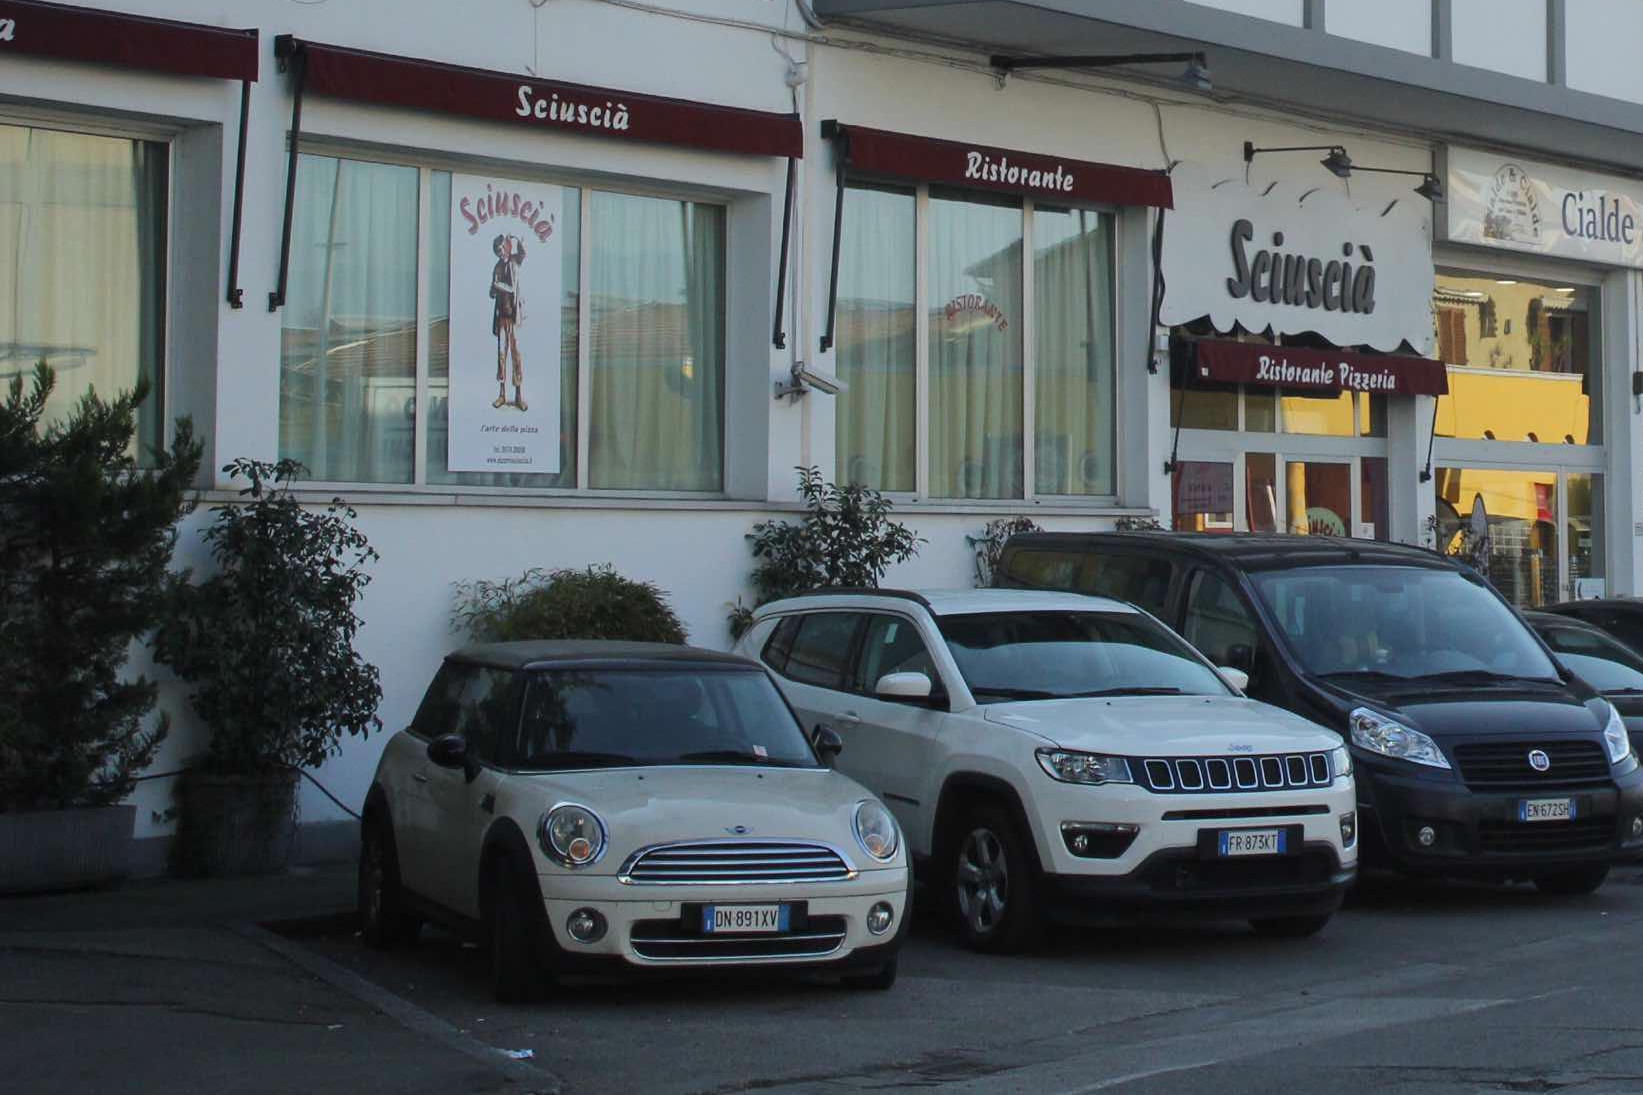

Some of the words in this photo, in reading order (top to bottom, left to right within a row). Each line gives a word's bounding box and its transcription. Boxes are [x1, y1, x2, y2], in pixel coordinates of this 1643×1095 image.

[515, 85, 630, 130] Sciuscià
[965, 151, 1074, 192] Ristorante
[459, 183, 555, 243] Sciuscià
[1562, 192, 1634, 245] Cialde
[1226, 218, 1376, 315] Sciuscià
[945, 294, 1009, 332] RISTORANTE
[1256, 356, 1334, 385] Ristorante
[1339, 362, 1396, 390] Pizzeria
[1229, 834, 1243, 851] FR
[1245, 833, 1276, 850] 873KT
[715, 910, 732, 928] DN
[736, 910, 778, 927] 891XV
